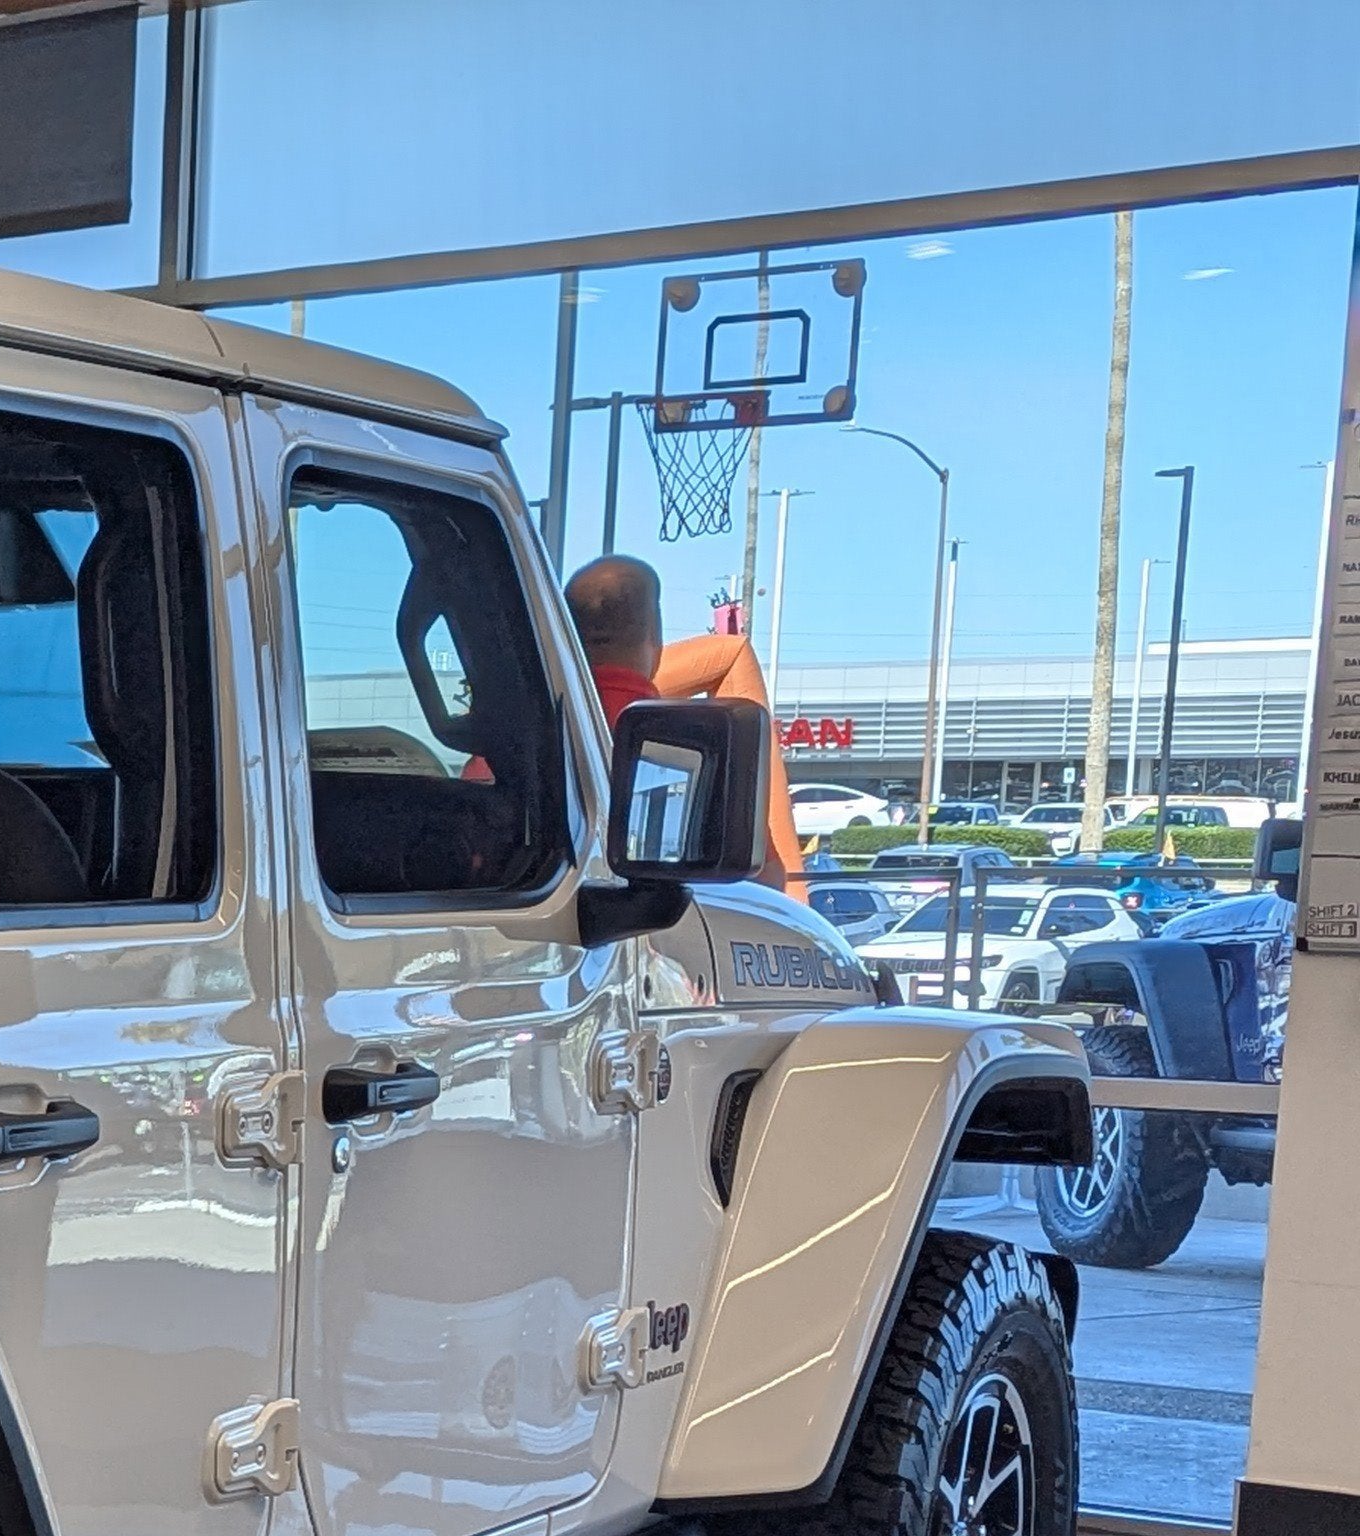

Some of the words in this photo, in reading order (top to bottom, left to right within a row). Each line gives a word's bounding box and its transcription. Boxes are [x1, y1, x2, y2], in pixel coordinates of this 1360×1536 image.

[1309, 905, 1343, 917] SHIFT
[1347, 904, 1355, 916] 2
[1308, 923, 1343, 935] SHIFT
